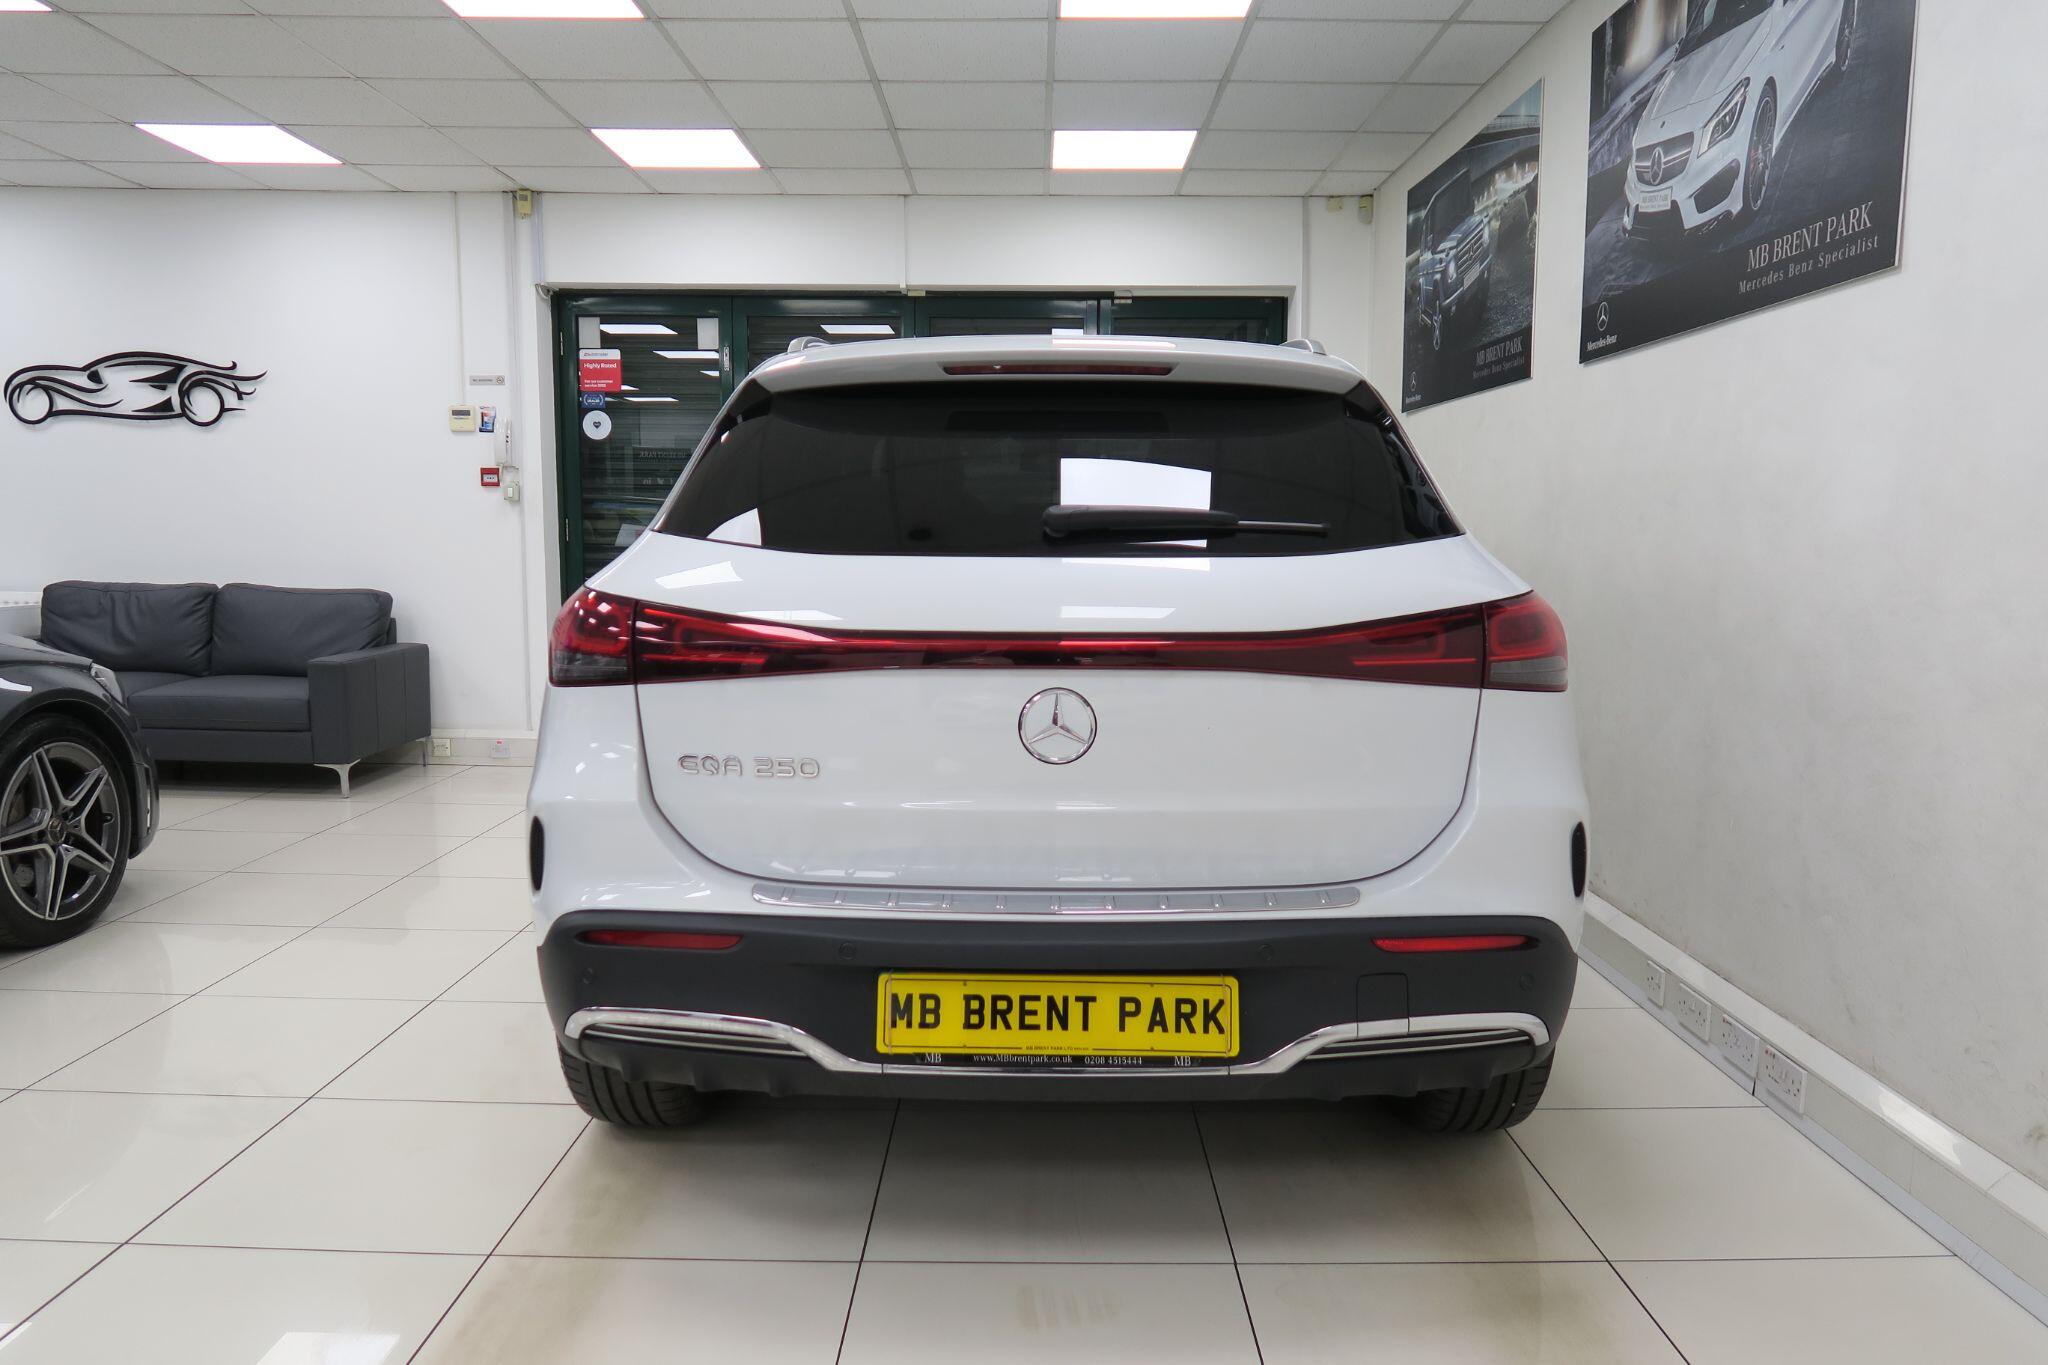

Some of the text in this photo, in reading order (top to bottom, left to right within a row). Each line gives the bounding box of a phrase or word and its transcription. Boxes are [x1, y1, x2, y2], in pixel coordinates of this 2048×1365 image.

[1747, 201, 1873, 272] MB BRENT PARK
[1738, 235, 1879, 294] Mercedes Benz Specialist
[1485, 342, 1505, 363] BRENT
[1505, 336, 1523, 357] PARK
[677, 754, 820, 779] EQA 250
[890, 992, 1226, 1035] MB BRENT PARK
[924, 1052, 942, 1063] MB
[972, 1053, 1073, 1065] www.MBbrentpark.co.uk
[1084, 1056, 1106, 1065] 0208
[1173, 1055, 1192, 1067] MB
